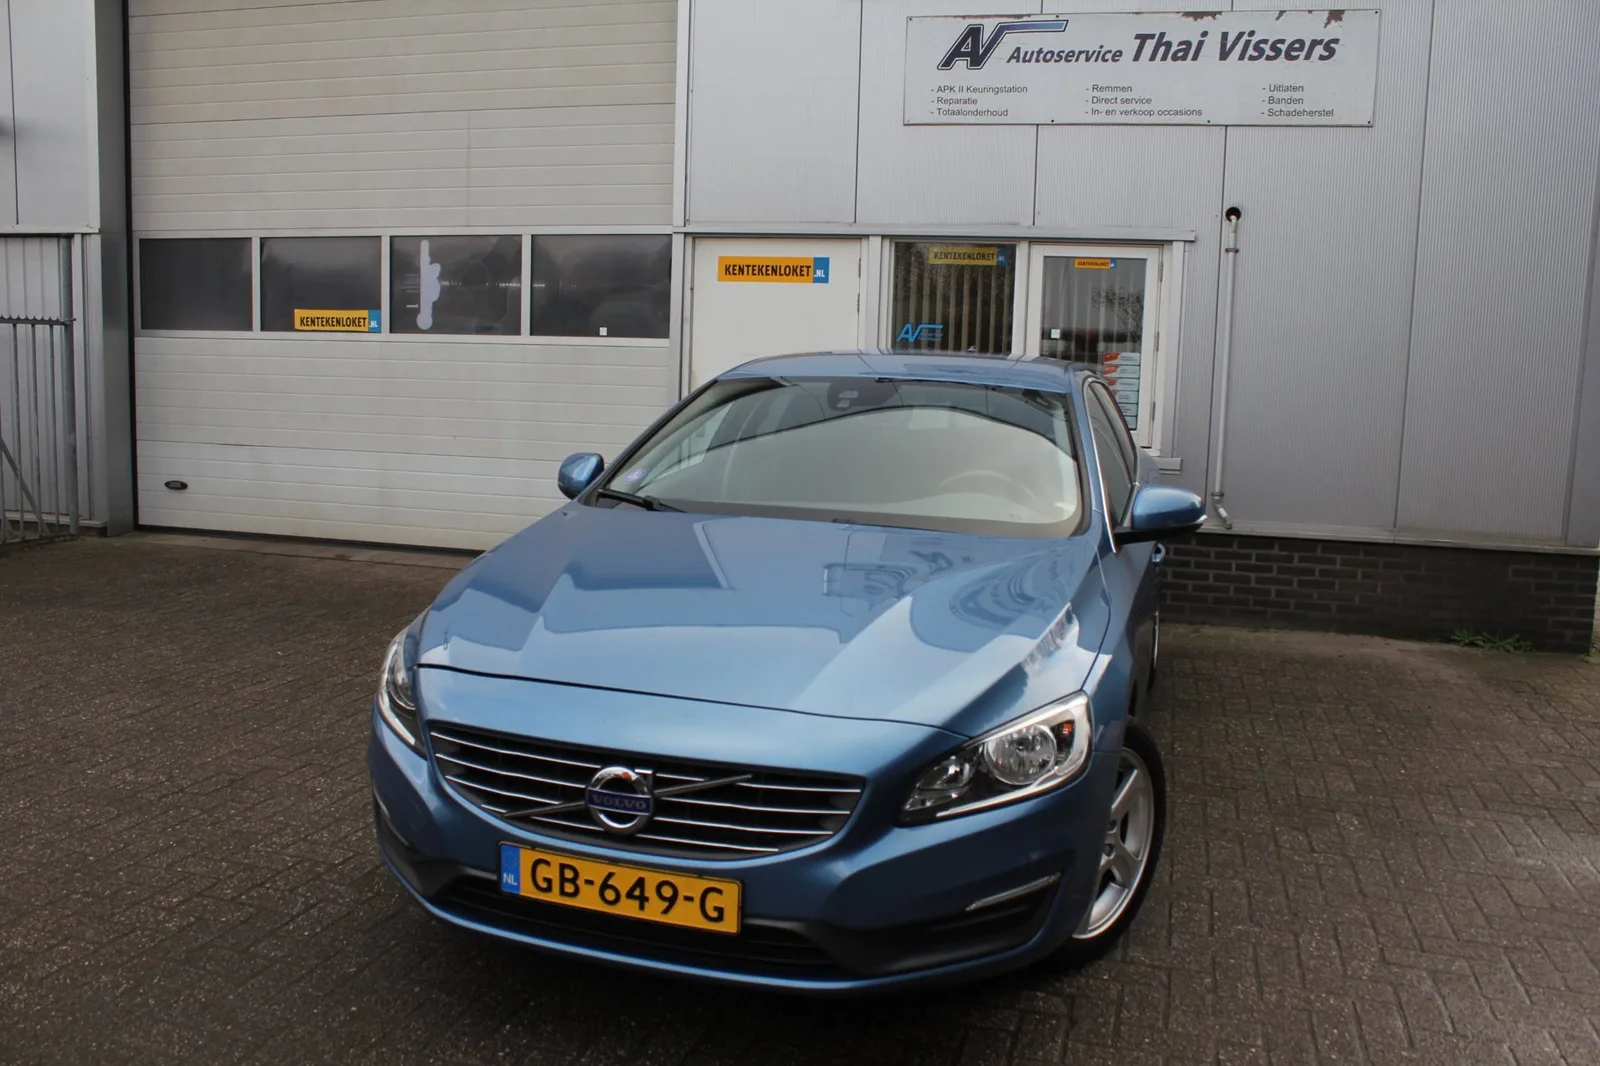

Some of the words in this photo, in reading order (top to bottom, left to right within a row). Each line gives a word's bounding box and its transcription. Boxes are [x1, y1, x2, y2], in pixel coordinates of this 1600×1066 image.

[1006, 45, 1123, 63] Autoservice
[1132, 31, 1209, 62] Thai
[1218, 30, 1340, 62] Vissers
[936, 85, 956, 93] APK
[966, 84, 1028, 95] Keuringstation
[1091, 84, 1133, 93] Remmen
[1268, 83, 1304, 93] Uitlaten
[936, 96, 978, 106] Reparatie
[1091, 95, 1118, 104] Direct
[1119, 95, 1153, 105] service
[1267, 95, 1304, 105] Banden
[936, 107, 1009, 117] Totaalonderhoud
[1091, 107, 1103, 116] In-
[1105, 108, 1117, 116] en
[1119, 108, 1155, 117] verkoop
[1156, 107, 1203, 117] occasions
[1267, 107, 1335, 118] Schadeherstel
[592, 794, 647, 810] VOLVO
[503, 872, 518, 886] NL
[530, 858, 725, 923] GB-649-G
